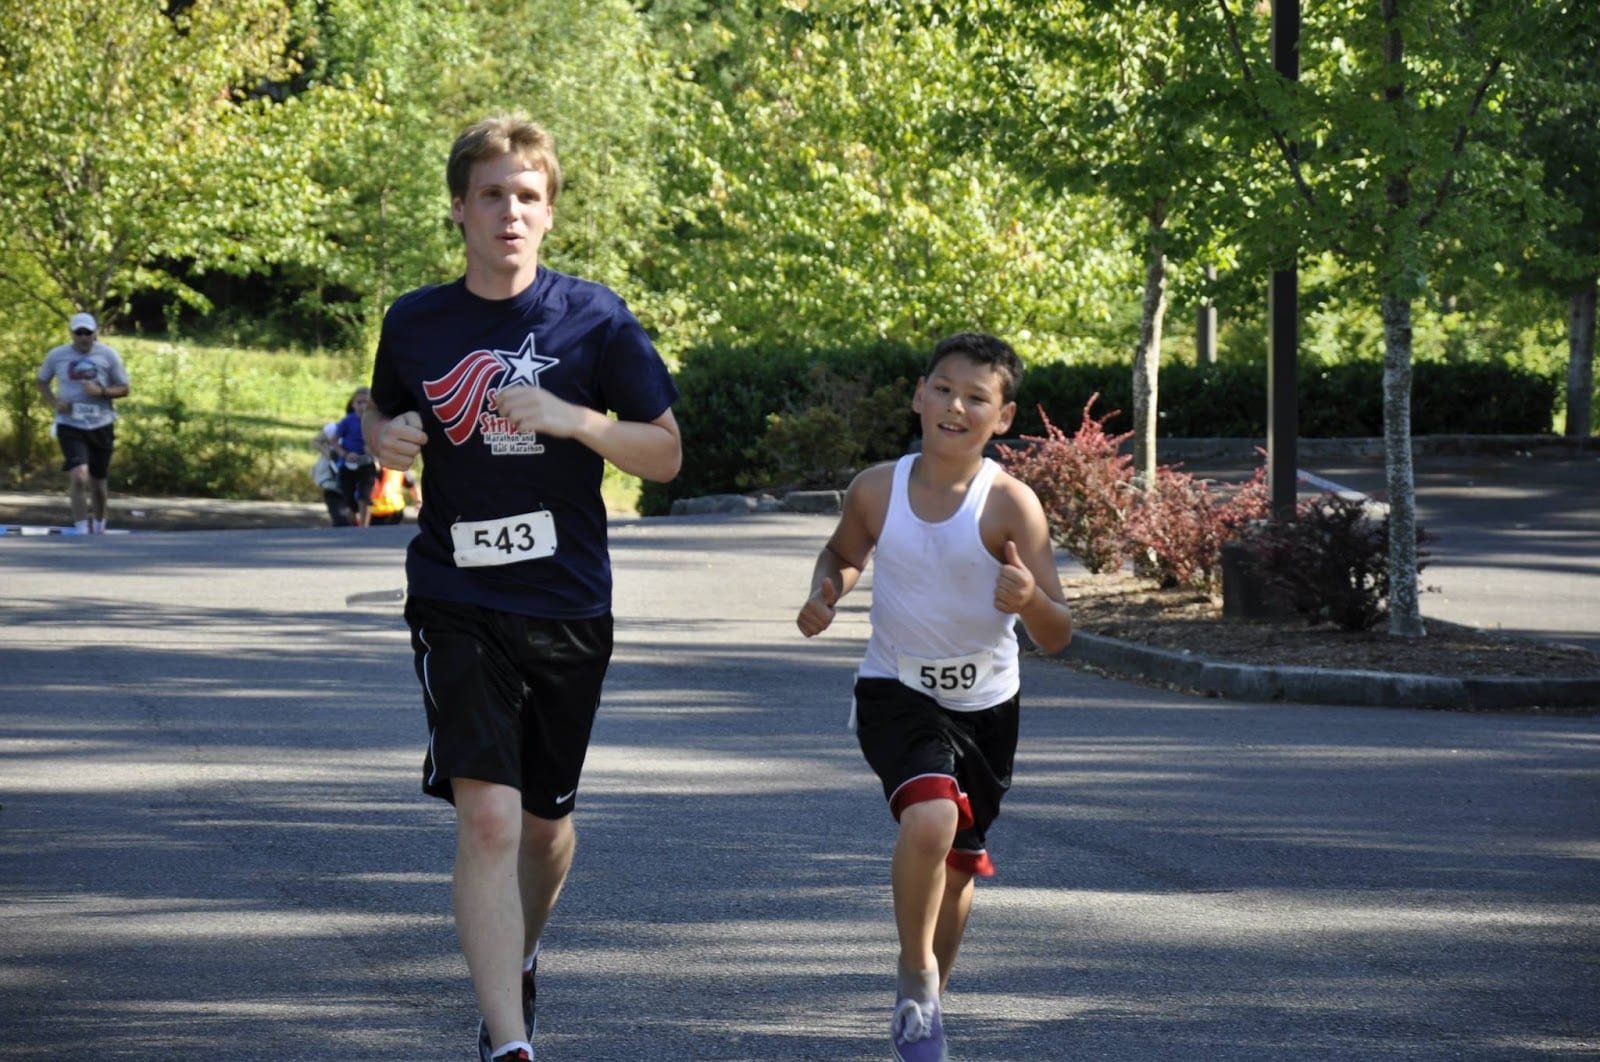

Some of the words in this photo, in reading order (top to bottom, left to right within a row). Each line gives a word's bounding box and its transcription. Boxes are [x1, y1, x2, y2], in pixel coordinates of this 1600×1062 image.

[485, 432, 520, 443] Marathon
[521, 433, 535, 442] and
[493, 443, 508, 453] Half
[509, 443, 544, 453] Marathon
[474, 523, 535, 555] 543
[920, 663, 977, 690] 559
